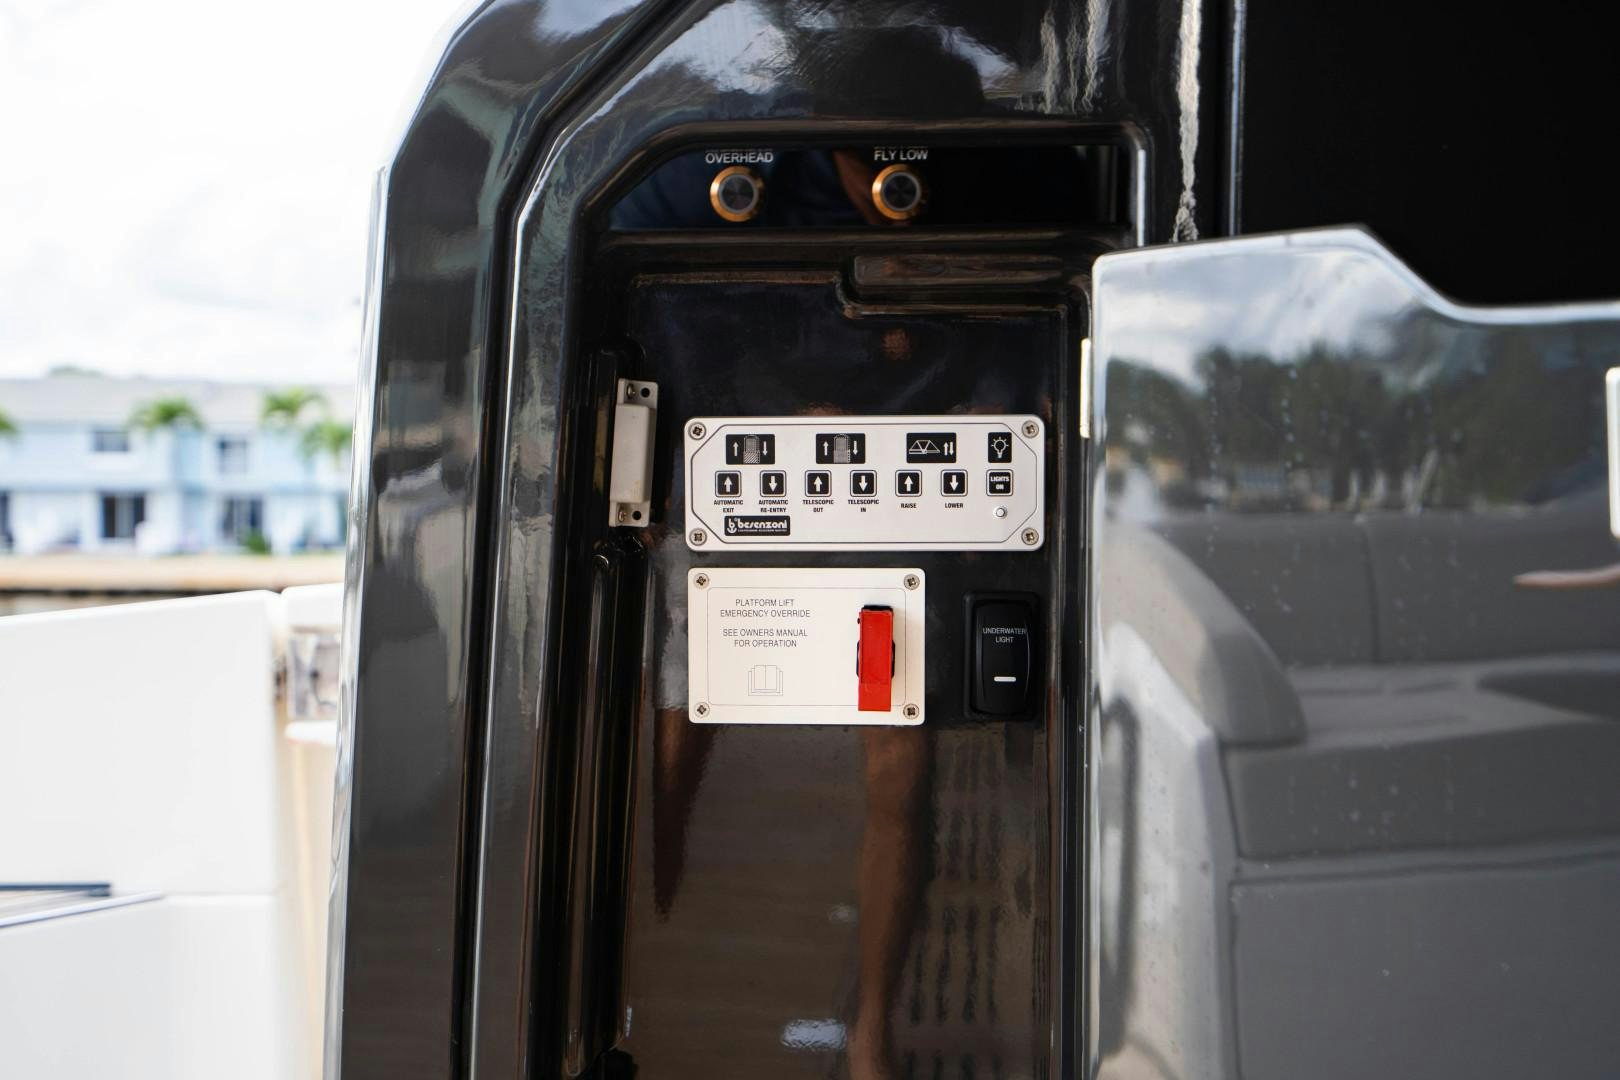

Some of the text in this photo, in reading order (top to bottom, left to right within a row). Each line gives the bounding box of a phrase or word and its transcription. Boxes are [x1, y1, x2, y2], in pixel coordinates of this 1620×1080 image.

[705, 152, 774, 164] OVERHEAD
[874, 150, 928, 160] FLY LOW
